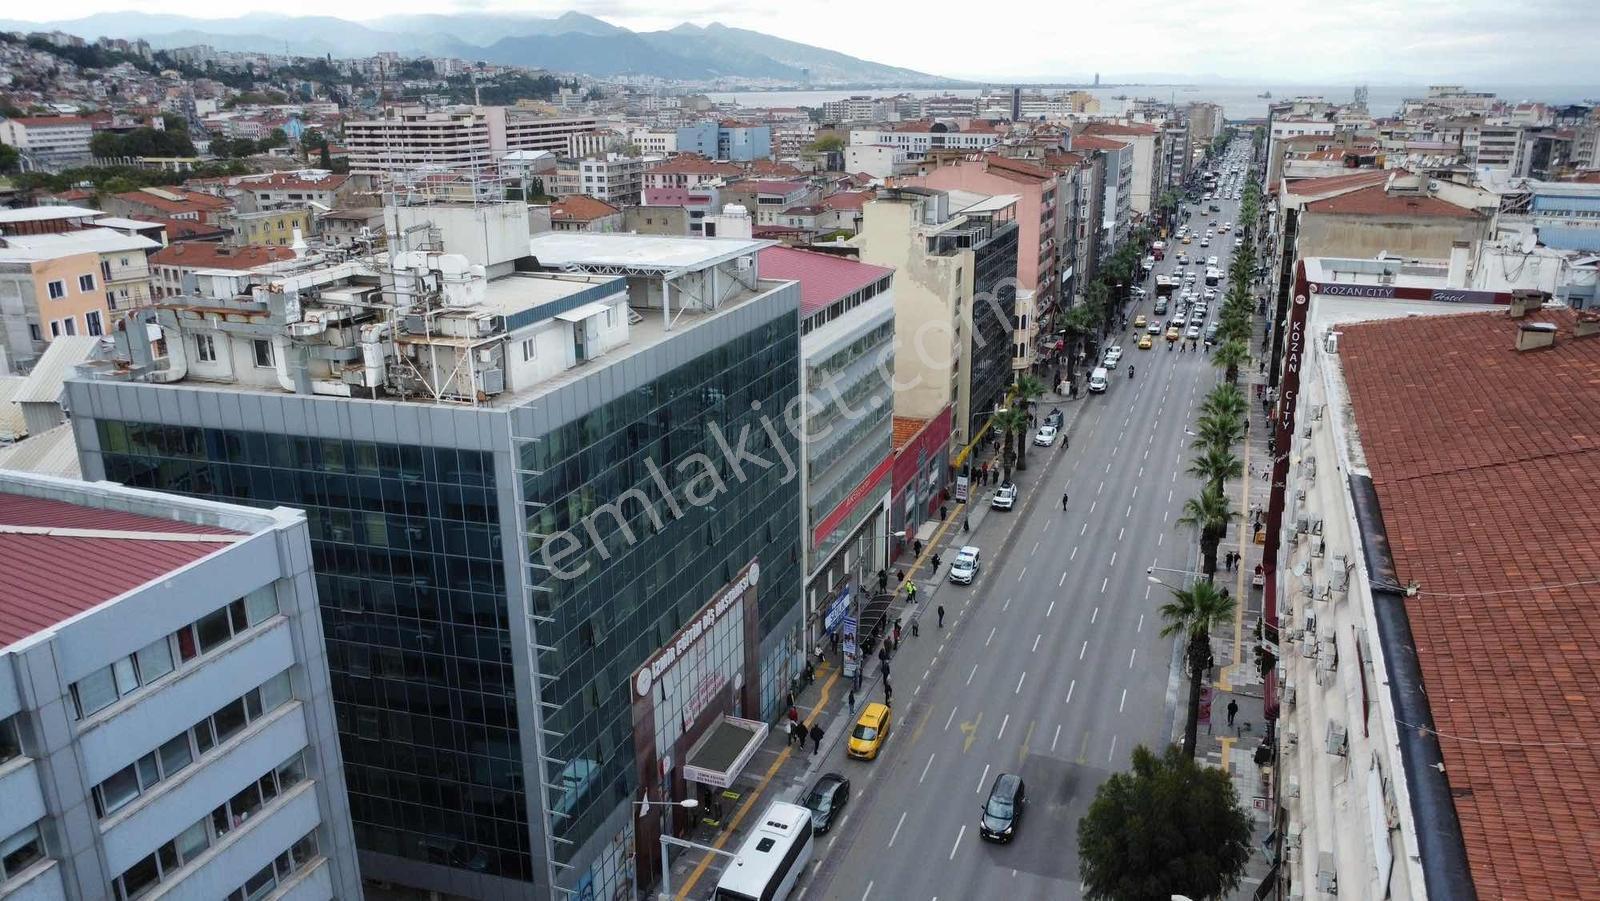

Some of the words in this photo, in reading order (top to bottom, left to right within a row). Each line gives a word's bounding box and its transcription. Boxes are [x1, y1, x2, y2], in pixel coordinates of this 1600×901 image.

[1323, 286, 1363, 297] KOZAN
[1366, 288, 1393, 297] CITY
[1433, 292, 1466, 302] Hotel
[1288, 321, 1301, 373] KOZAN
[1283, 390, 1293, 430] CITY
